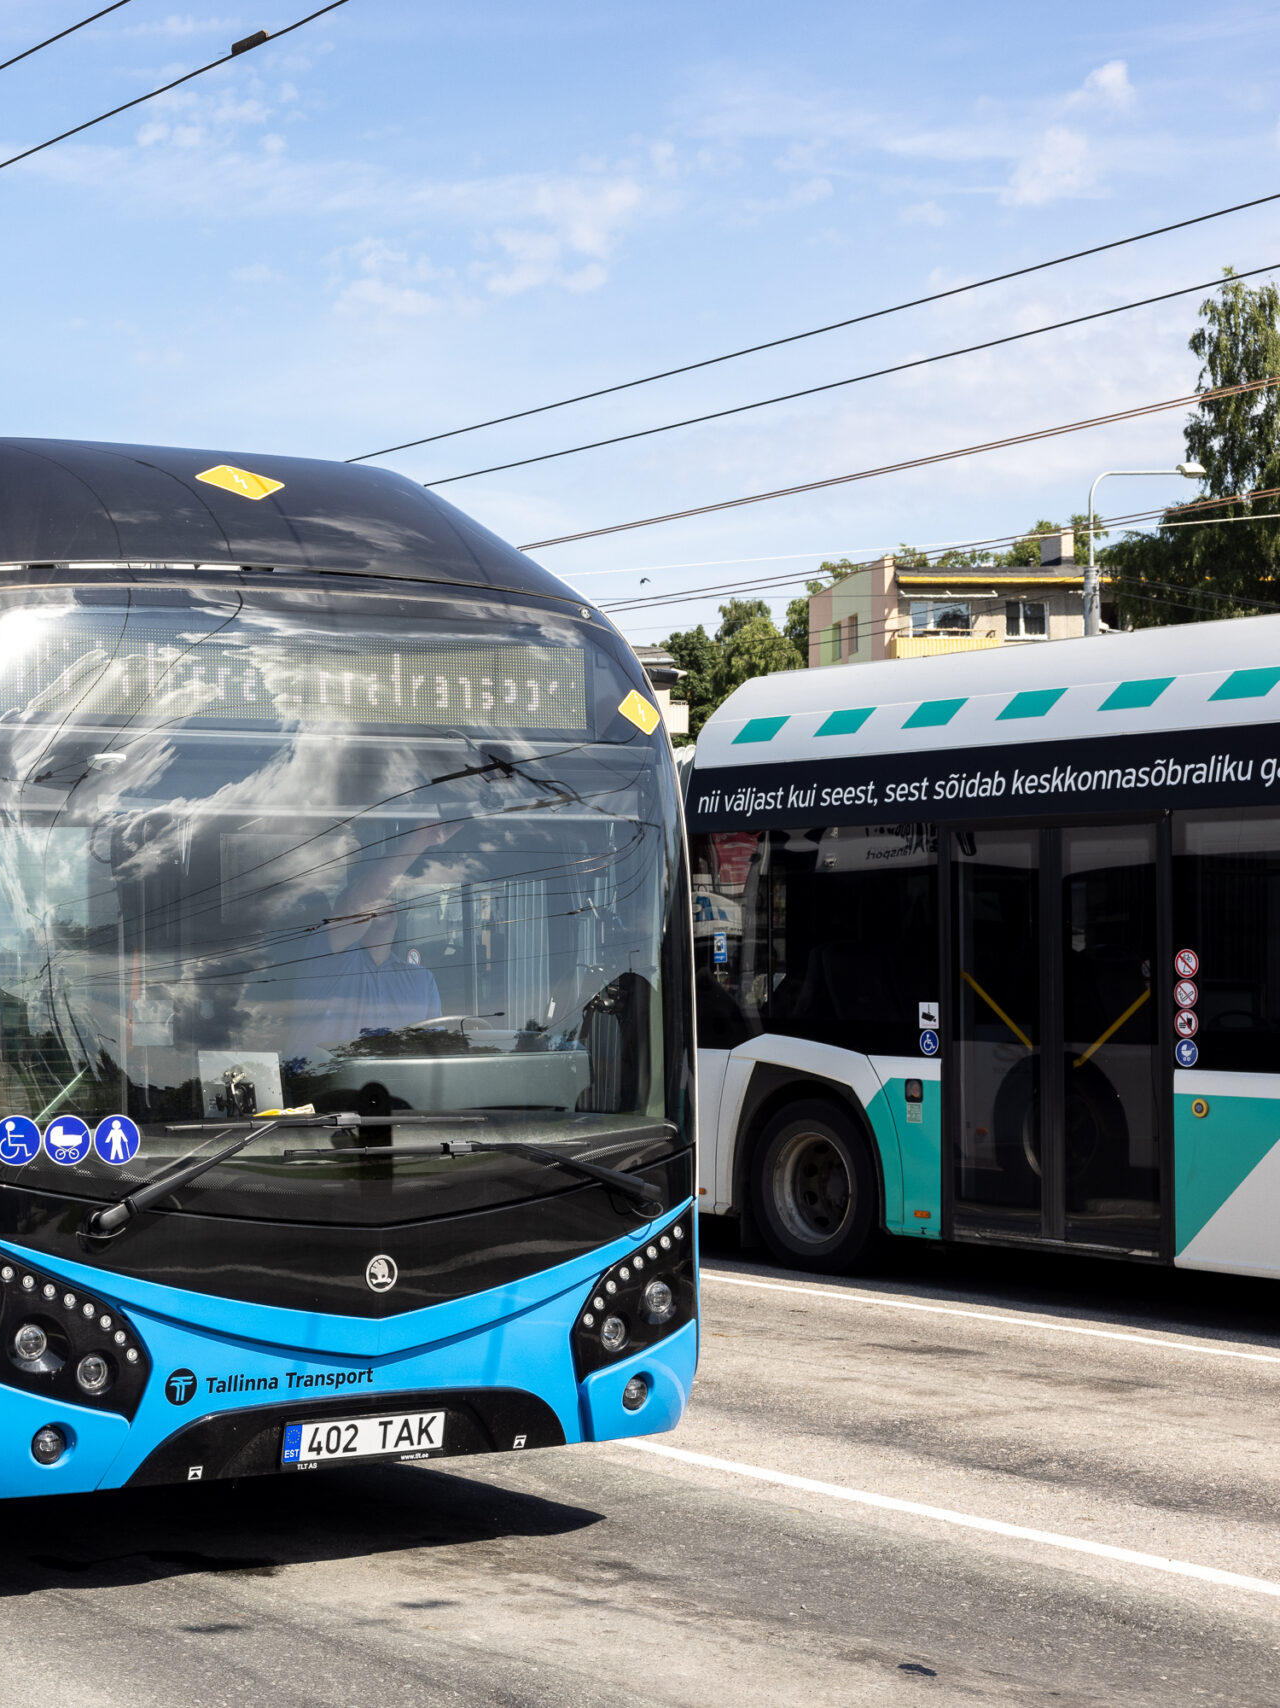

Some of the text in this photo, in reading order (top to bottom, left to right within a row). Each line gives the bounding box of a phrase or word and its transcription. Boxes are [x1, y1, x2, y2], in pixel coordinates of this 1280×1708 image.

[697, 753, 1280, 817] nii väljast kui seest, sest sõidab keskkonnasõbraliku g
[205, 1367, 374, 1395] Tallinna Transport
[307, 1415, 436, 1457] 402 TAK
[283, 1448, 300, 1459] EST
[296, 1462, 318, 1471] TLT AS
